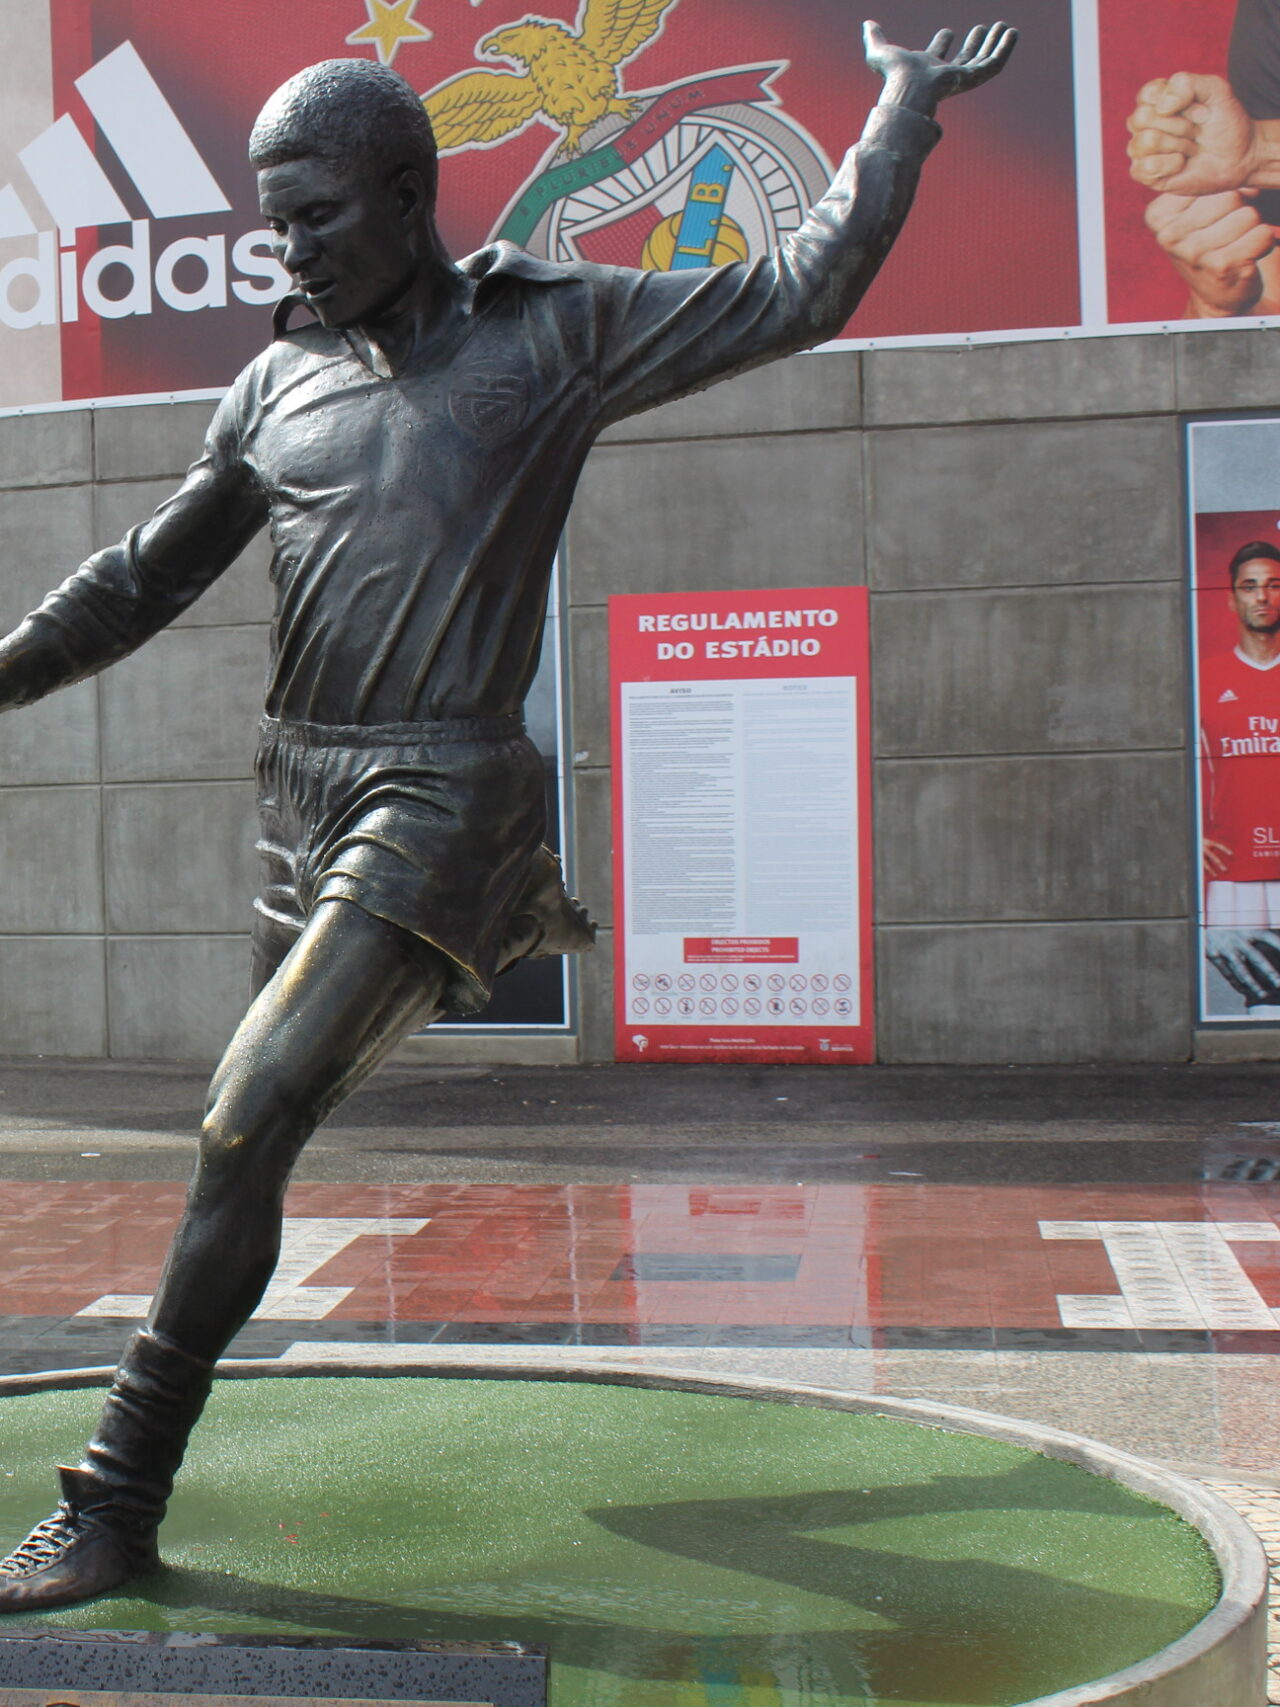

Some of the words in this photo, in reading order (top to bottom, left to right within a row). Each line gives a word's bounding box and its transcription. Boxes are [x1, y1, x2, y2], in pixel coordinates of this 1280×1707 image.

[638, 608, 839, 632] REGULAMENTO
[657, 641, 695, 660] DO
[705, 635, 821, 659] ESTÁDIO
[1248, 716, 1278, 733] Fly
[1253, 827, 1280, 844] SL
